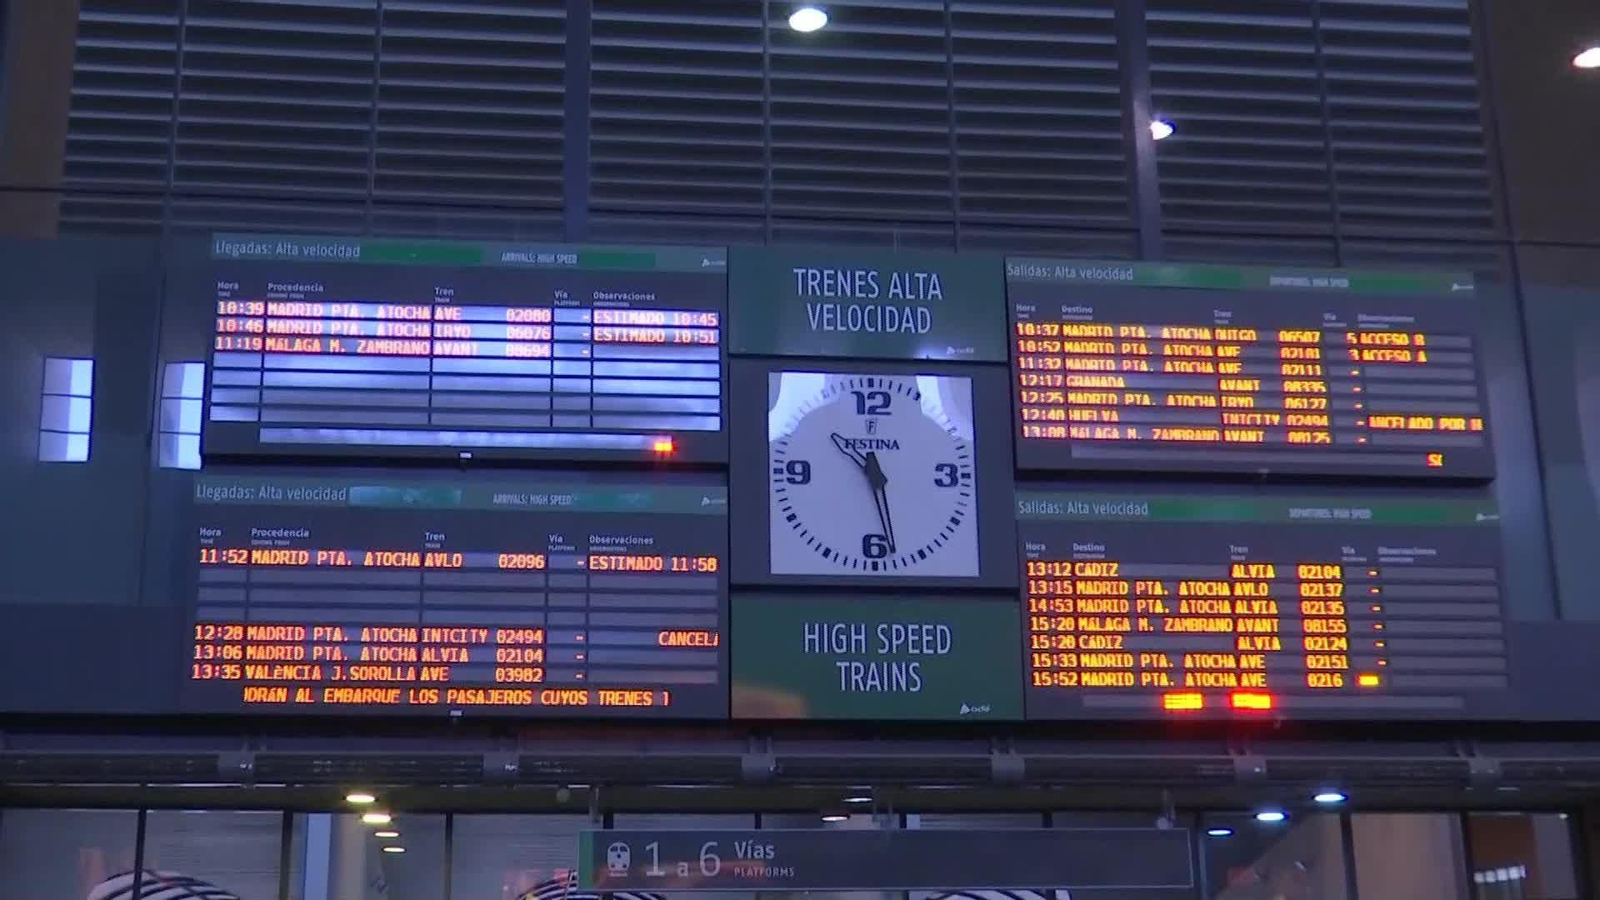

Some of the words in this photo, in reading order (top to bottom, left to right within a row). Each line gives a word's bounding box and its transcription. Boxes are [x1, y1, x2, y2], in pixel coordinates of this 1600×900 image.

[216, 241, 272, 255] Llegadas:
[276, 241, 299, 255] Alta
[303, 244, 360, 258] velocidad
[557, 254, 577, 264] SPEED
[1008, 266, 1050, 277] Salidas:
[1055, 266, 1075, 277] Alta
[1080, 268, 1133, 280] velocidad
[218, 282, 239, 290] Hora
[268, 282, 323, 292] Procedencia
[435, 288, 453, 296] Tren
[594, 292, 654, 300] Observaciones
[794, 269, 878, 298] TRENES
[889, 272, 942, 300] ALTA
[267, 303, 322, 316] MADRID
[331, 304, 365, 317] PTA.
[378, 306, 430, 319] ATOCHA
[435, 307, 460, 320] AVE
[594, 312, 665, 325] ESTIMADO
[674, 313, 717, 325] 10:45
[807, 304, 931, 333] VELOCIDAD
[266, 320, 322, 334] MADRID
[331, 322, 365, 335] PTA.
[377, 323, 430, 336] ATOCHA
[594, 329, 665, 342] ESTIMADO
[674, 330, 716, 343] 10:51
[215, 337, 261, 350] 11:19
[330, 340, 346, 352] M.
[358, 340, 430, 354] ZAMBRANO
[852, 391, 892, 415] 12
[844, 439, 900, 450] FESTINA
[786, 460, 811, 485] 9
[934, 464, 958, 487] 3
[196, 485, 253, 500] Llegadas:
[259, 486, 282, 500] Alta
[287, 488, 346, 501] velocidad
[550, 494, 572, 505] SPEED
[1019, 501, 1063, 513] Salidas:
[1067, 502, 1089, 513] Alta
[1094, 502, 1148, 515] velocidad
[200, 528, 221, 536] Hora
[251, 528, 309, 538] Procedencia
[425, 532, 444, 541] Tren
[549, 534, 562, 543] Vía
[590, 536, 654, 544] Observaciones
[862, 534, 887, 558] 6
[1073, 543, 1105, 551] Destino
[200, 549, 247, 563] 11:52
[252, 551, 308, 565] MADRID
[317, 551, 352, 565] PTA.
[365, 552, 420, 567] ATOCHA
[424, 554, 462, 568] AVLO
[498, 555, 544, 568] 02096
[590, 556, 662, 570] ESTIMADO
[671, 558, 717, 571] 11:58
[1028, 562, 1071, 576] 13:12
[1232, 565, 1274, 578] ALVIA
[1299, 565, 1341, 578] 02104
[1029, 581, 1072, 594] 13:15
[1077, 582, 1128, 595] MADRID
[1136, 583, 1168, 595] PTA.
[1180, 583, 1230, 596] ATOCHA
[1234, 583, 1268, 596] AVLO
[1301, 583, 1342, 596] 02137
[1030, 600, 1073, 613] 14:53
[1077, 600, 1128, 613] MADRID
[1137, 600, 1169, 613] PTA.
[1180, 601, 1231, 614] ATOCHA
[1236, 601, 1277, 613] ALVIA
[1302, 601, 1344, 614] 02135
[1031, 617, 1074, 630] 15:20
[1139, 619, 1154, 631] M.
[1164, 619, 1233, 632] ZAMBRANO
[1237, 619, 1279, 632] AVANT
[195, 626, 243, 640] 12:28
[247, 627, 304, 641] MADRID
[313, 627, 348, 641] PTA.
[361, 628, 417, 642] ATOCHA
[421, 630, 487, 644] INTCITY
[496, 630, 543, 644] 02494
[804, 623, 866, 653] HIGH
[877, 624, 951, 654] SPEED
[1032, 635, 1075, 648] 15:20
[1238, 637, 1280, 650] ALVIA
[1305, 637, 1347, 650] 02124
[194, 645, 242, 659] 13:06
[246, 646, 304, 660] MADRID
[313, 647, 348, 661] PTA.
[361, 648, 416, 661] ATOCHA
[421, 649, 468, 663] ALVIA
[496, 649, 543, 663] 02104
[1032, 653, 1077, 667] 15:33
[1081, 654, 1133, 667] MADRID
[1140, 655, 1173, 667] PTA.
[1184, 655, 1236, 668] ATOCHA
[1240, 655, 1265, 668] AVE
[1307, 655, 1348, 669] 02151
[192, 665, 241, 679] 13:35
[421, 668, 449, 681] AVE
[496, 668, 543, 682] 03982
[836, 662, 922, 691] TRAINS
[1033, 672, 1077, 686] 15:52
[1082, 673, 1134, 686] MADRID
[1141, 673, 1174, 686] PTA.
[1186, 673, 1237, 687] ATOCHA
[1241, 674, 1267, 686] AVE
[296, 688, 314, 702] AL
[324, 688, 400, 703] EMBARQUE
[409, 689, 438, 704] LOS
[448, 690, 532, 704] PASAJEROS
[541, 691, 588, 704] CUYOS
[599, 691, 652, 705] TRENES
[734, 841, 774, 859] Vías
[645, 842, 665, 876] 1
[677, 862, 688, 876] a
[700, 842, 720, 876] 6
[734, 867, 794, 877] PLATFORMS
